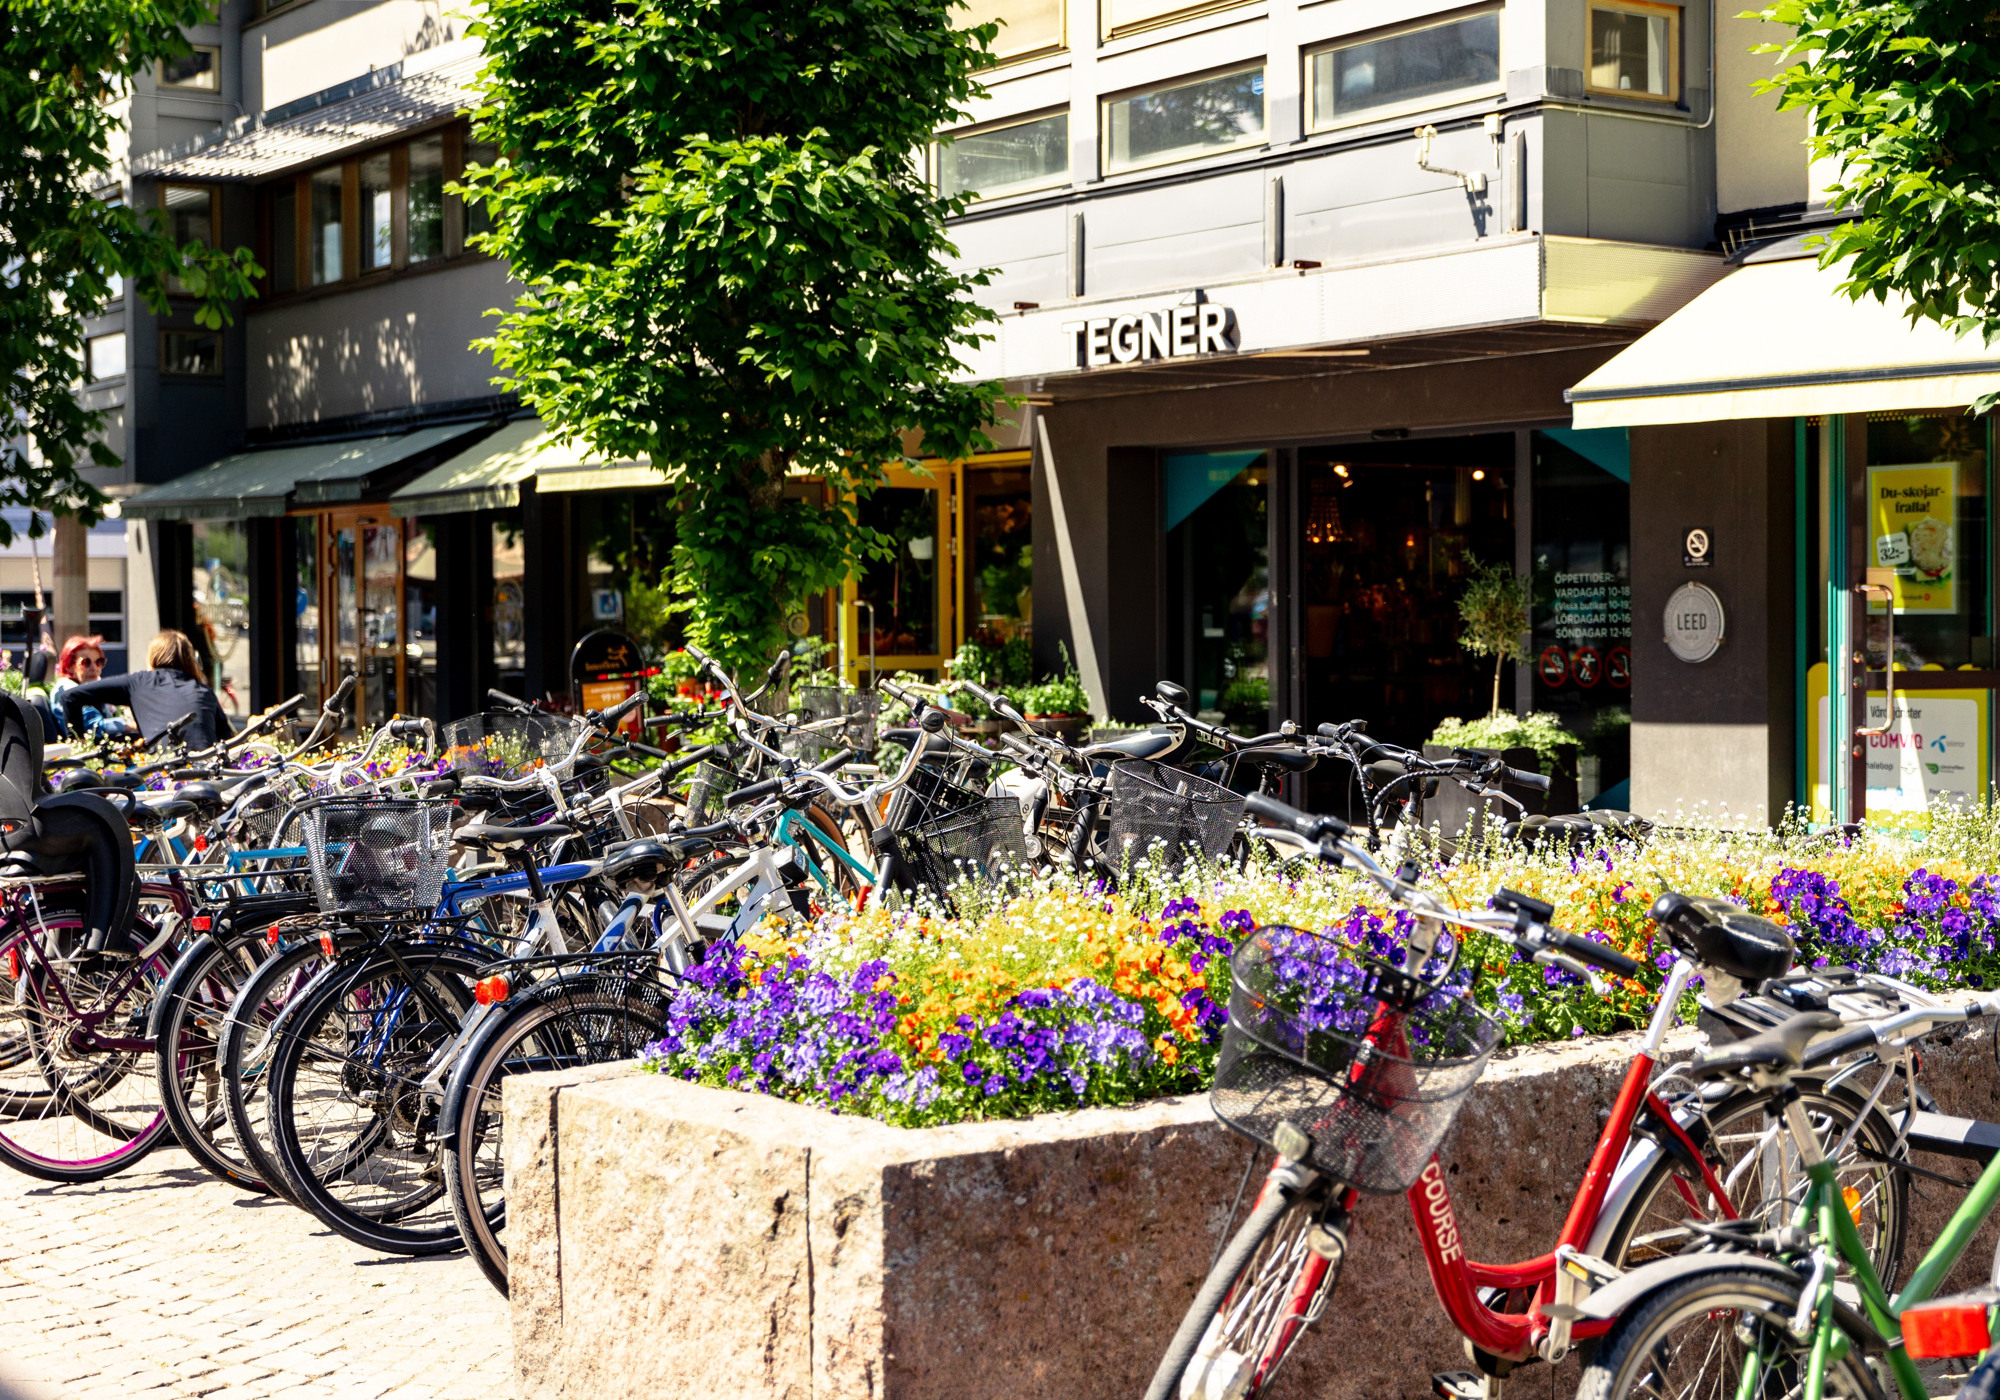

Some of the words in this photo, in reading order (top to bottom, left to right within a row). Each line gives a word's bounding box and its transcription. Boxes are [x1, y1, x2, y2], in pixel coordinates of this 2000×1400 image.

[1880, 485, 1945, 499] Du-skojar-
[1895, 501, 1930, 513] fralla!
[1554, 572, 1614, 584] ÖPPETTIDER:
[1554, 587, 1606, 598] VARDAGAR
[1608, 586, 1630, 596] 10-18
[1555, 612, 1606, 625] LÖRDAGAR
[1608, 613, 1631, 623] 10-16
[1677, 613, 1707, 631] LEED
[1555, 626, 1608, 639] SÖNDAGAR
[1609, 627, 1632, 638] 12-16
[1420, 1161, 1462, 1266] COURSE
